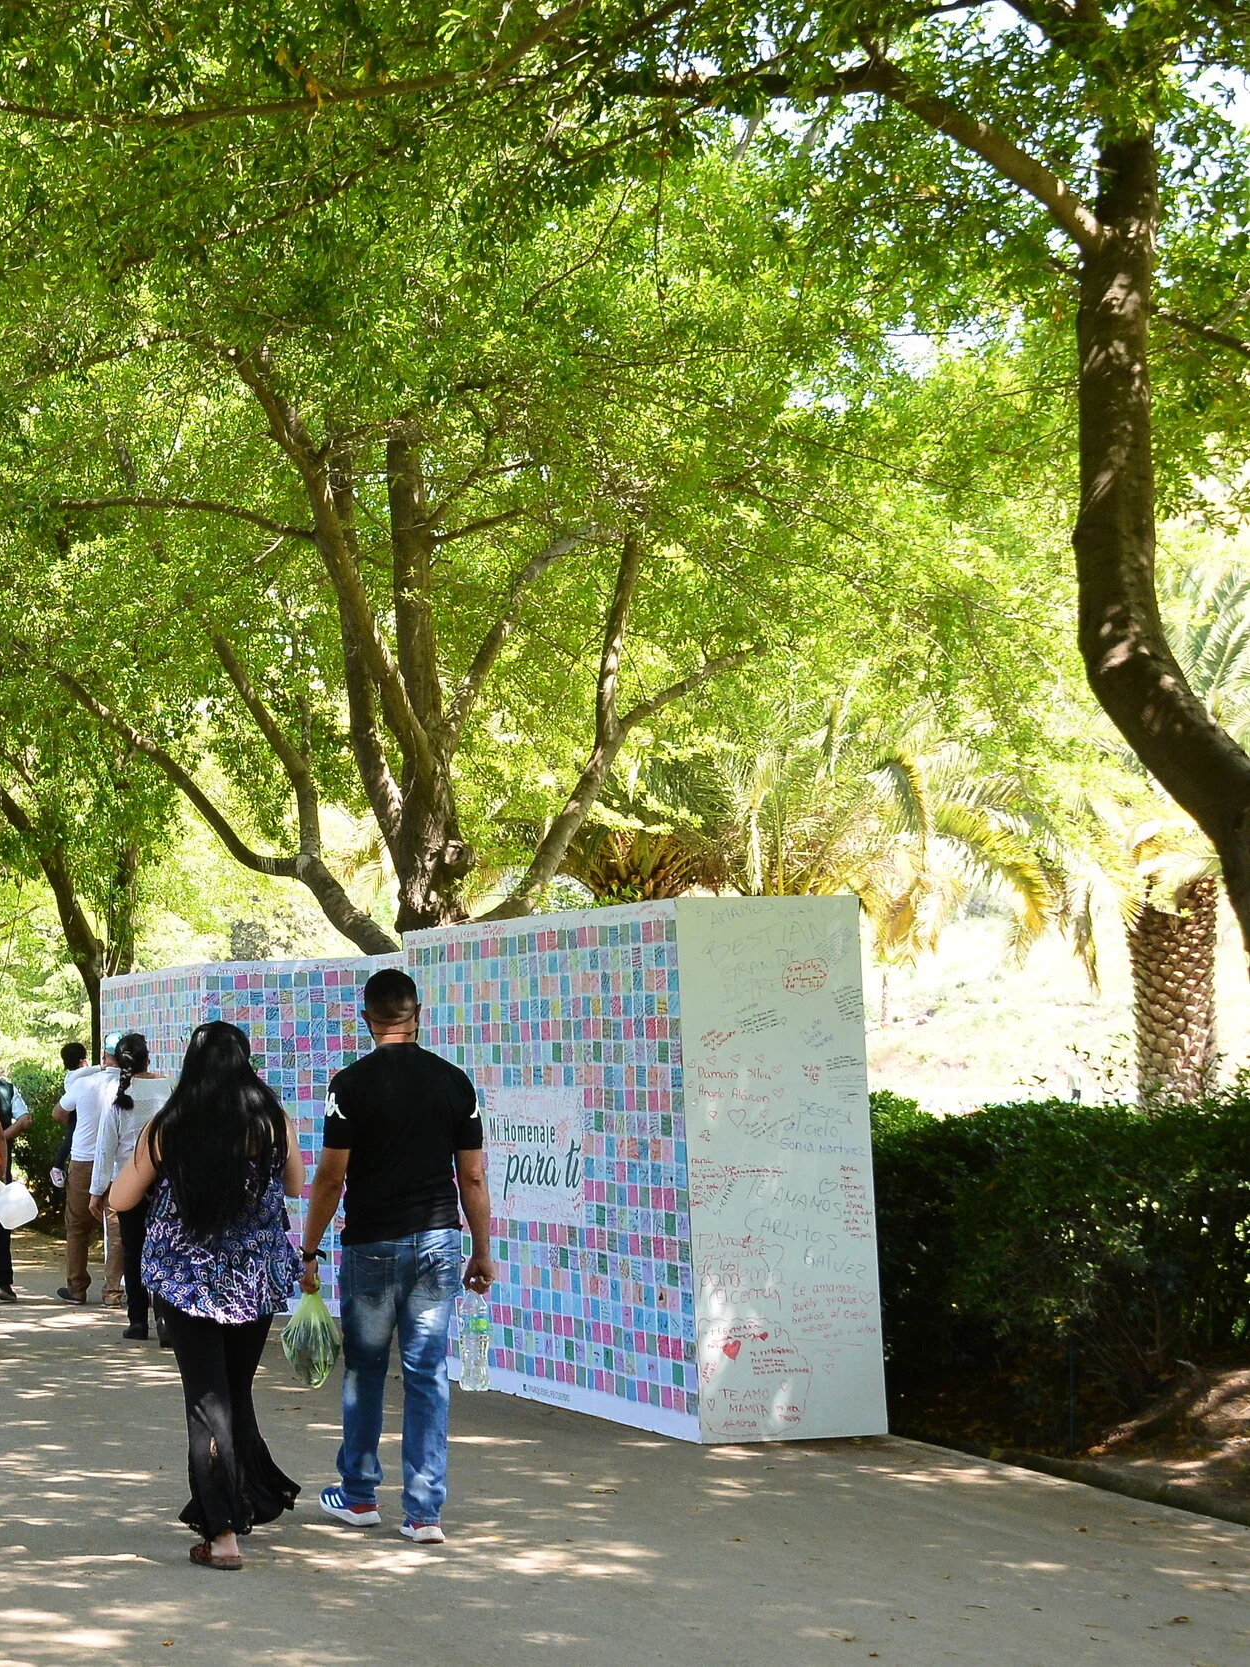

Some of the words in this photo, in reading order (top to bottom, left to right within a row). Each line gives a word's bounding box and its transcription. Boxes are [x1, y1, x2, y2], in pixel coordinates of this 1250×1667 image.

[698, 1066, 739, 1079] Damaris
[747, 1067, 772, 1080] Silva
[489, 1117, 500, 1141] Mi
[504, 1117, 556, 1149] Homenaje
[503, 1150, 562, 1200] para
[565, 1138, 582, 1189] ti
[770, 1187, 842, 1220] AMAMOS
[719, 1388, 739, 1400] TE
[743, 1388, 769, 1400] AMO
